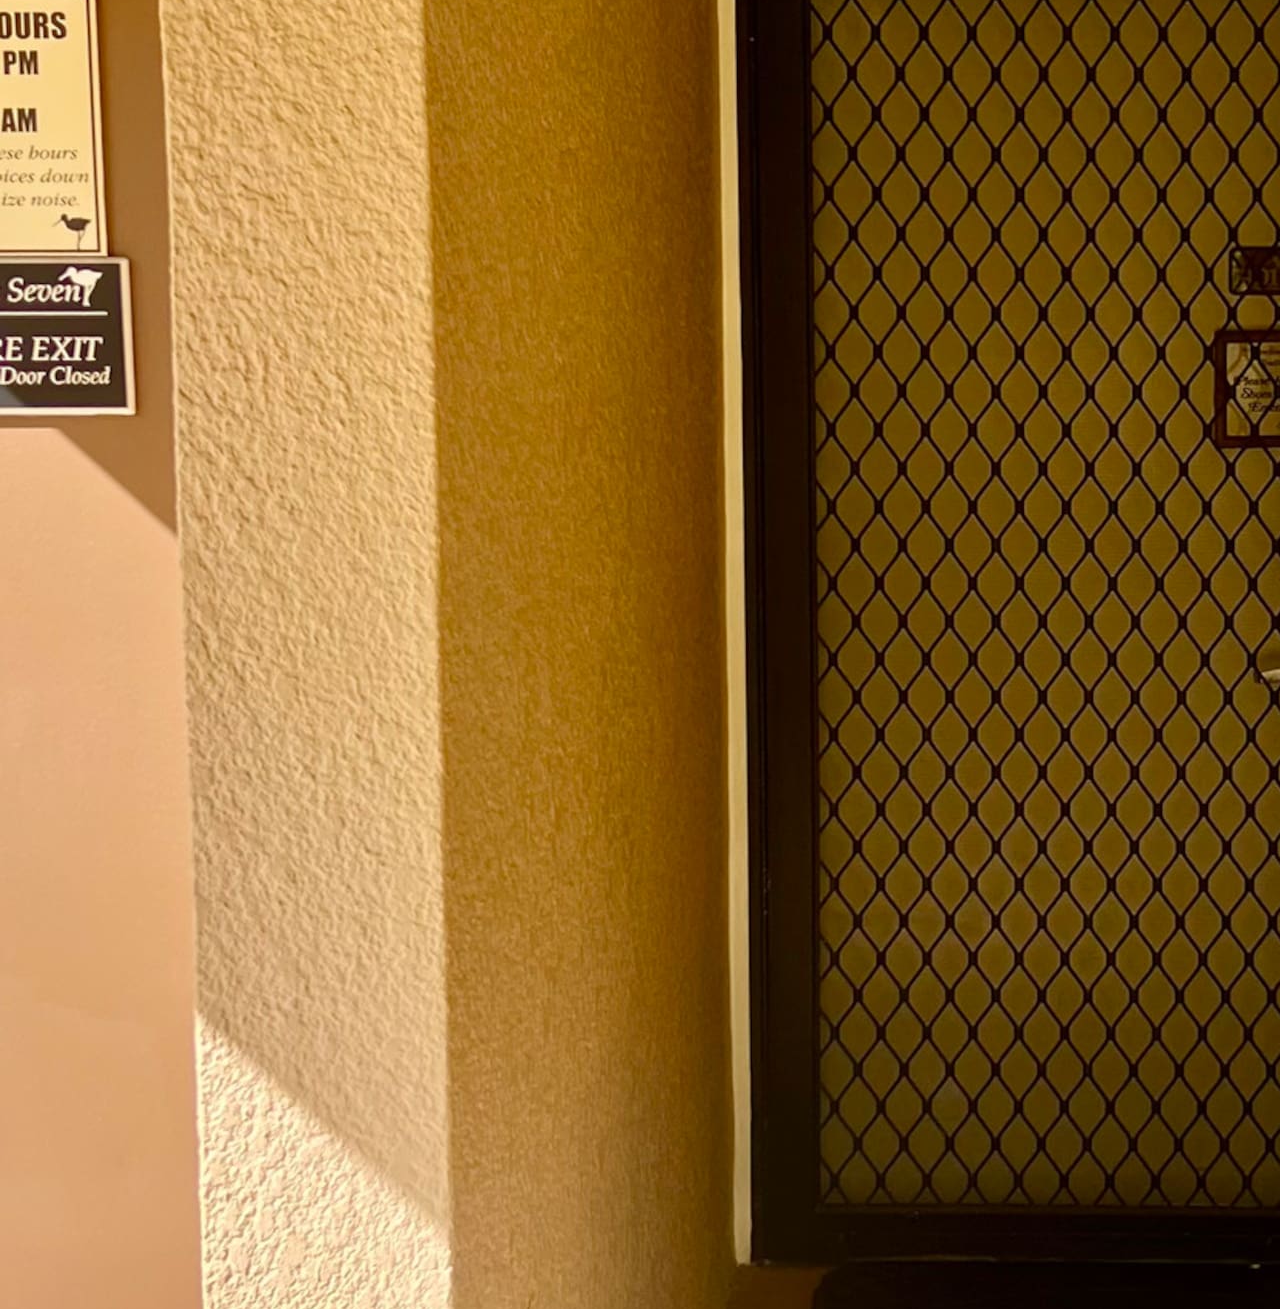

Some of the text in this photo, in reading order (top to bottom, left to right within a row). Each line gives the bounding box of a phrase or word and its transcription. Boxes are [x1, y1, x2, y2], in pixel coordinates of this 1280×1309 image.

[0, 11, 67, 39] OURS
[3, 50, 39, 75] PM
[1, 108, 38, 132] AM
[40, 168, 89, 183] down
[6, 277, 82, 302] Seven
[31, 336, 104, 362] EXIT
[0, 365, 111, 385] Door Closed
